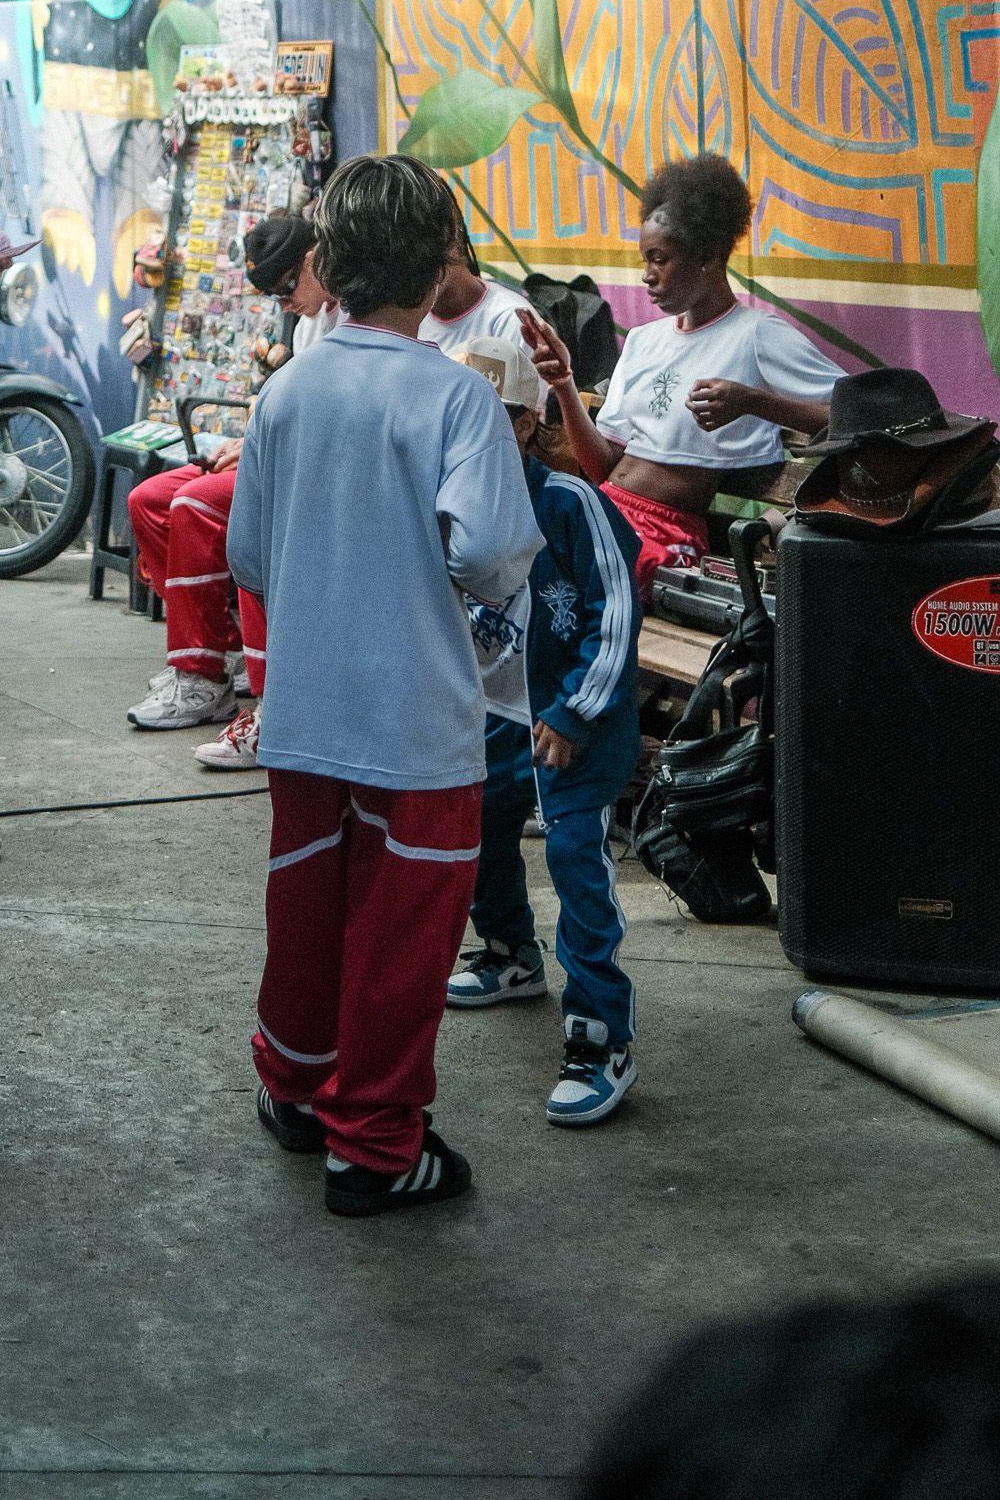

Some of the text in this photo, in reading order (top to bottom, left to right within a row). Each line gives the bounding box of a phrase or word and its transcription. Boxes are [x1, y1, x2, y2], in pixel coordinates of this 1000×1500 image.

[927, 601, 999, 612] HOME AUDIO SYSTEM
[924, 611, 997, 637] 1500W
